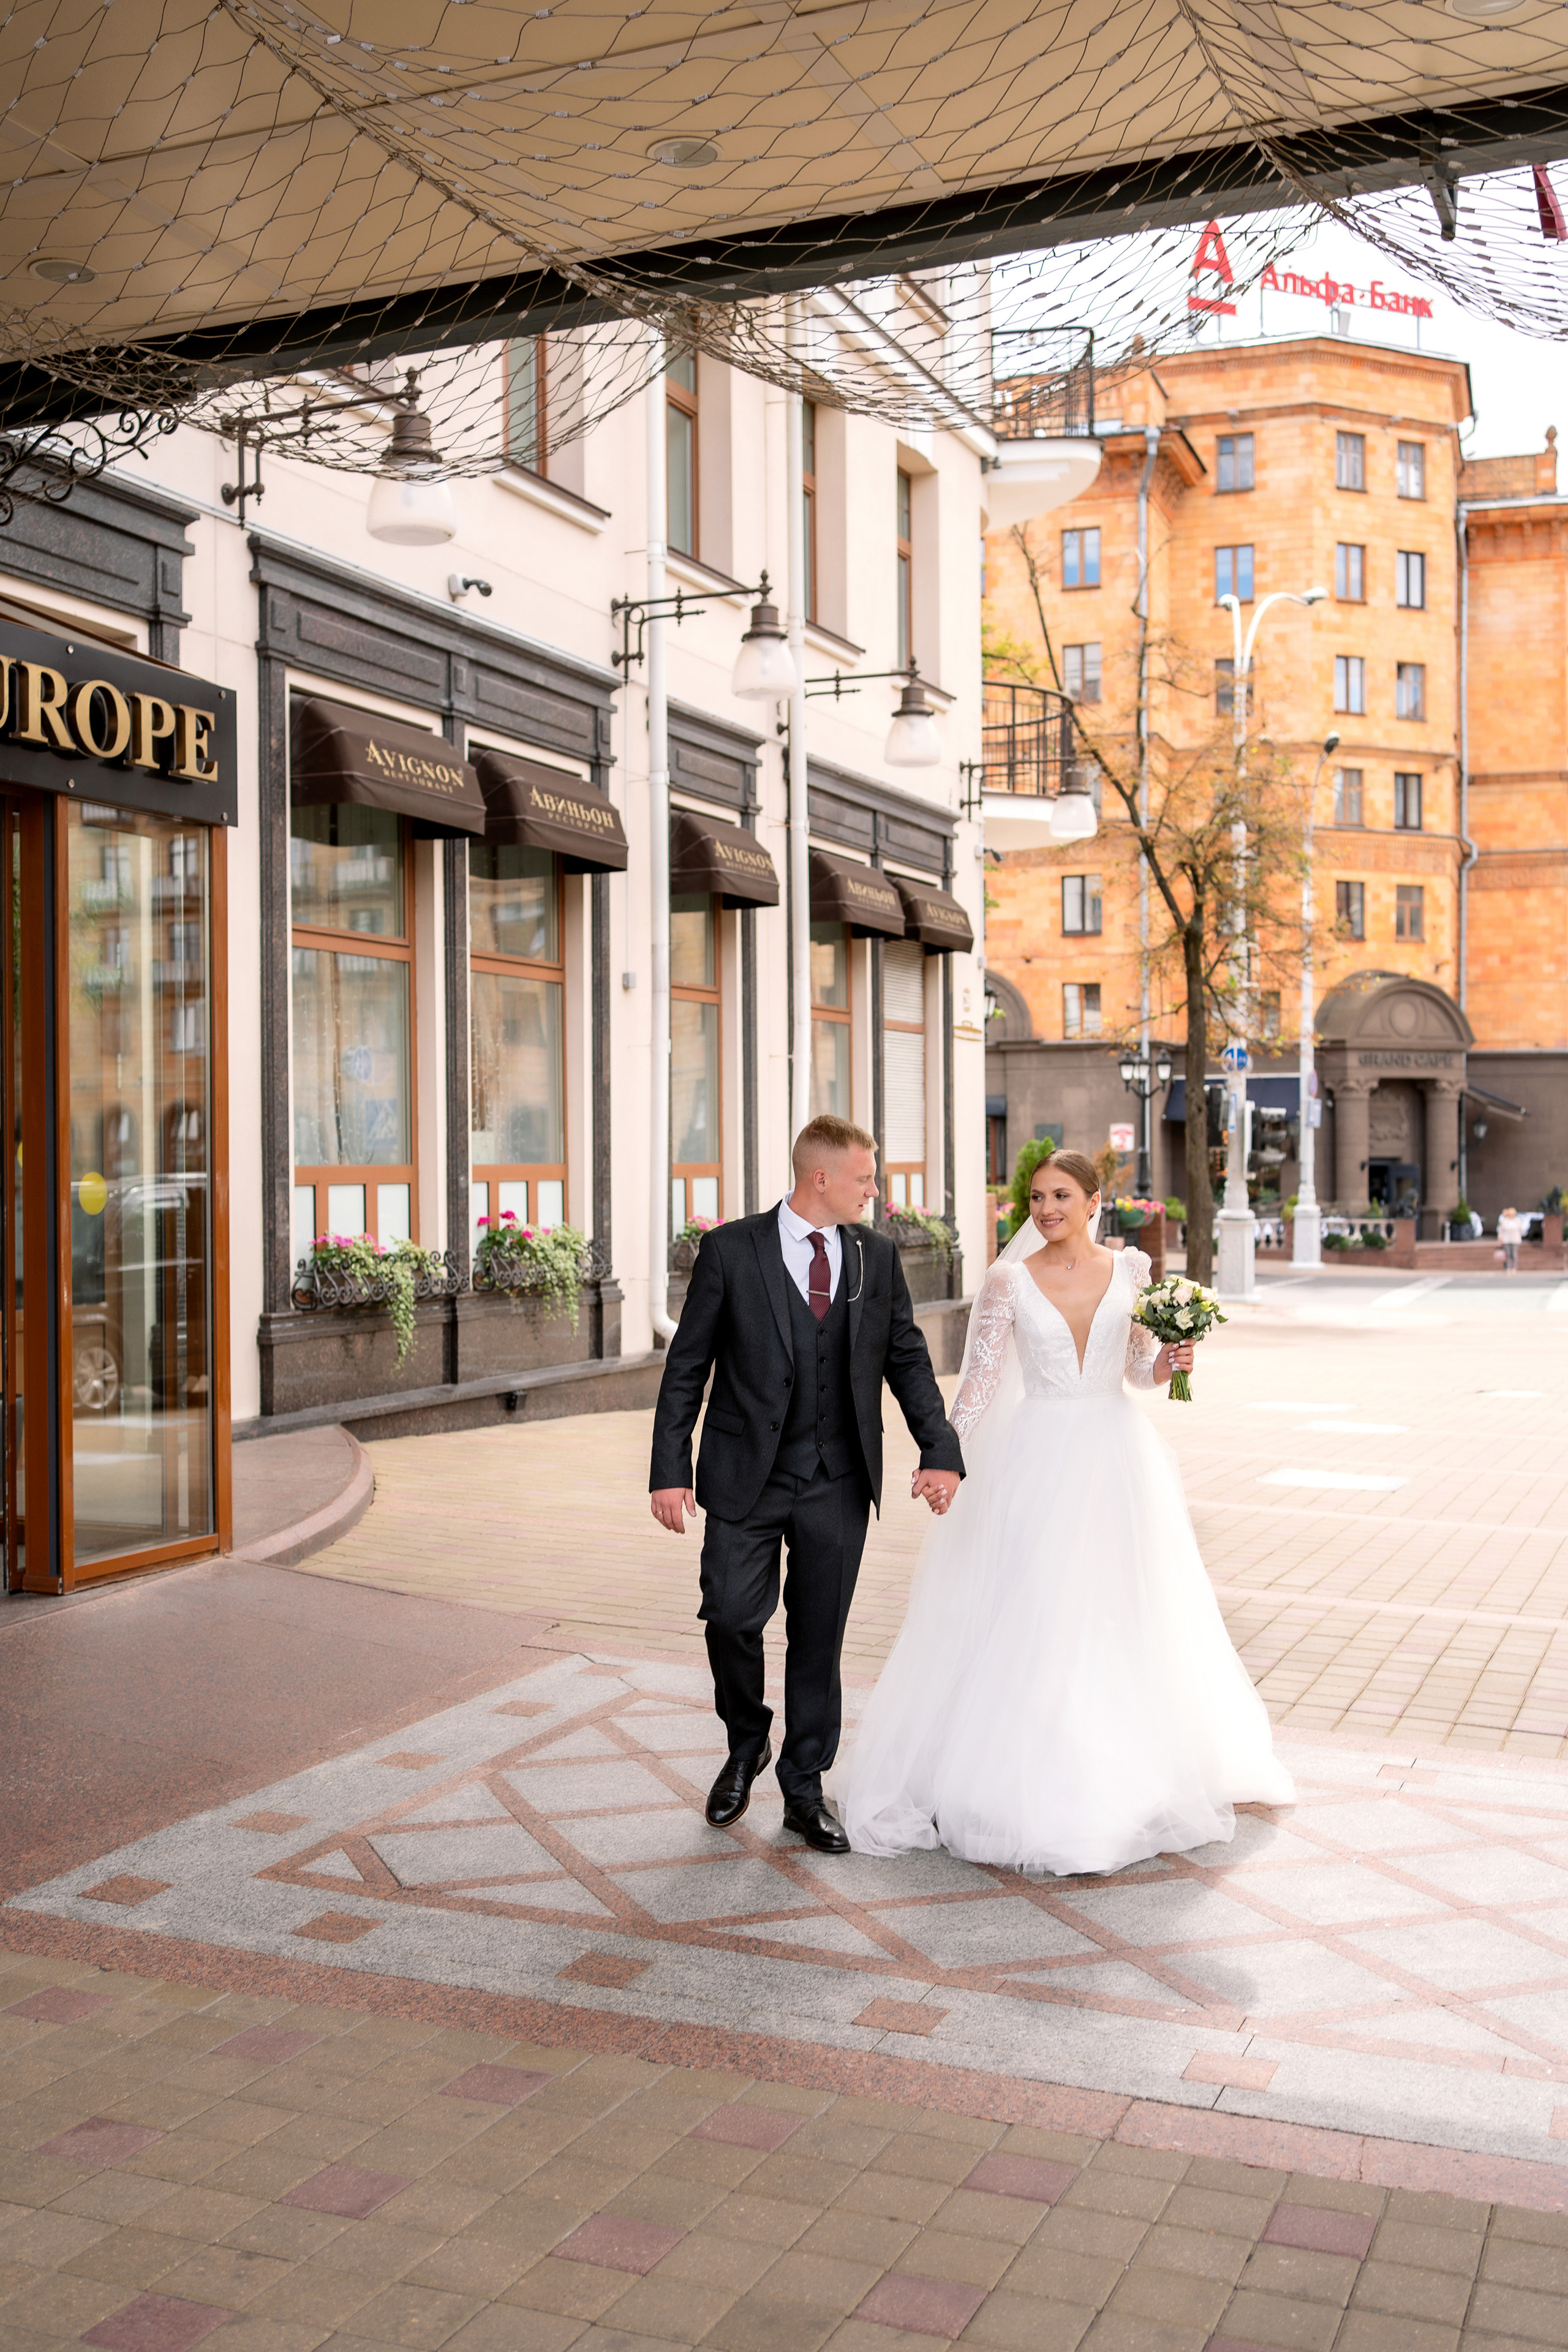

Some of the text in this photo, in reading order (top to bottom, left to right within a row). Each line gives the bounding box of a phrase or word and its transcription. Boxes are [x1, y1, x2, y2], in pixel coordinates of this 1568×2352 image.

[365, 739, 464, 788] AVIGNON
[529, 785, 615, 829] АВИНЬОН
[714, 839, 774, 871] AVIGNON
